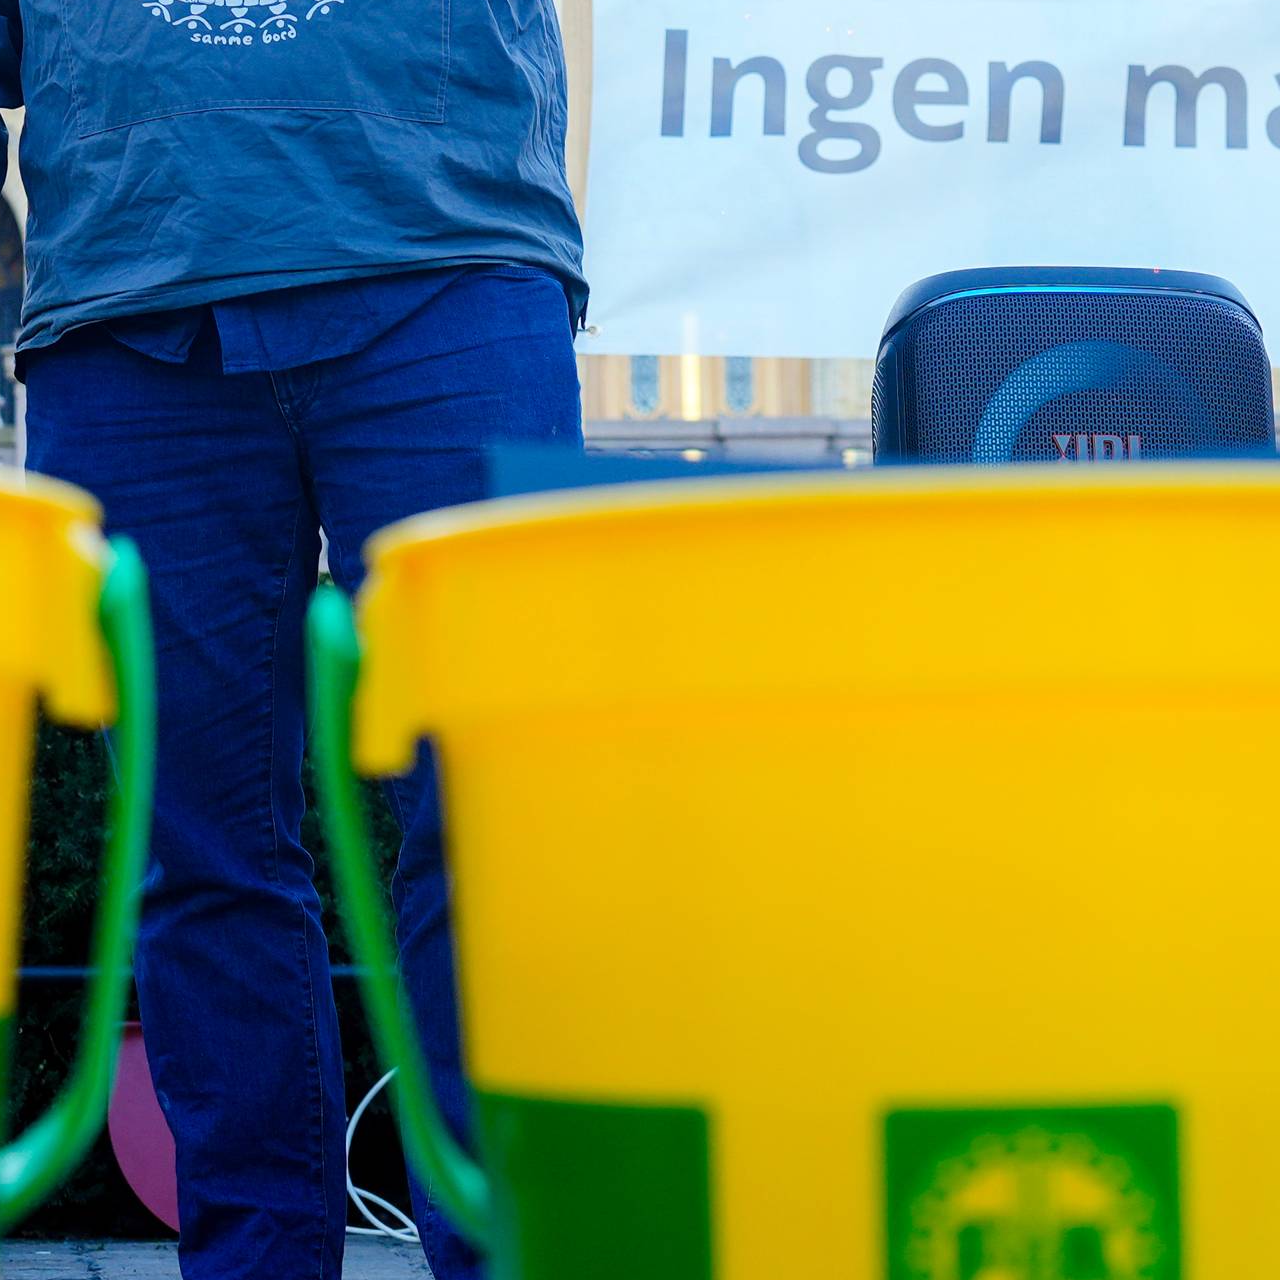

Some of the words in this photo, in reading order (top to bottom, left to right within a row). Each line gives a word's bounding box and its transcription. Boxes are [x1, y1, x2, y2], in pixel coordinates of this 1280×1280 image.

[190, 32, 253, 46] samme
[262, 24, 297, 44] bord
[660, 28, 1066, 175] Ingen
